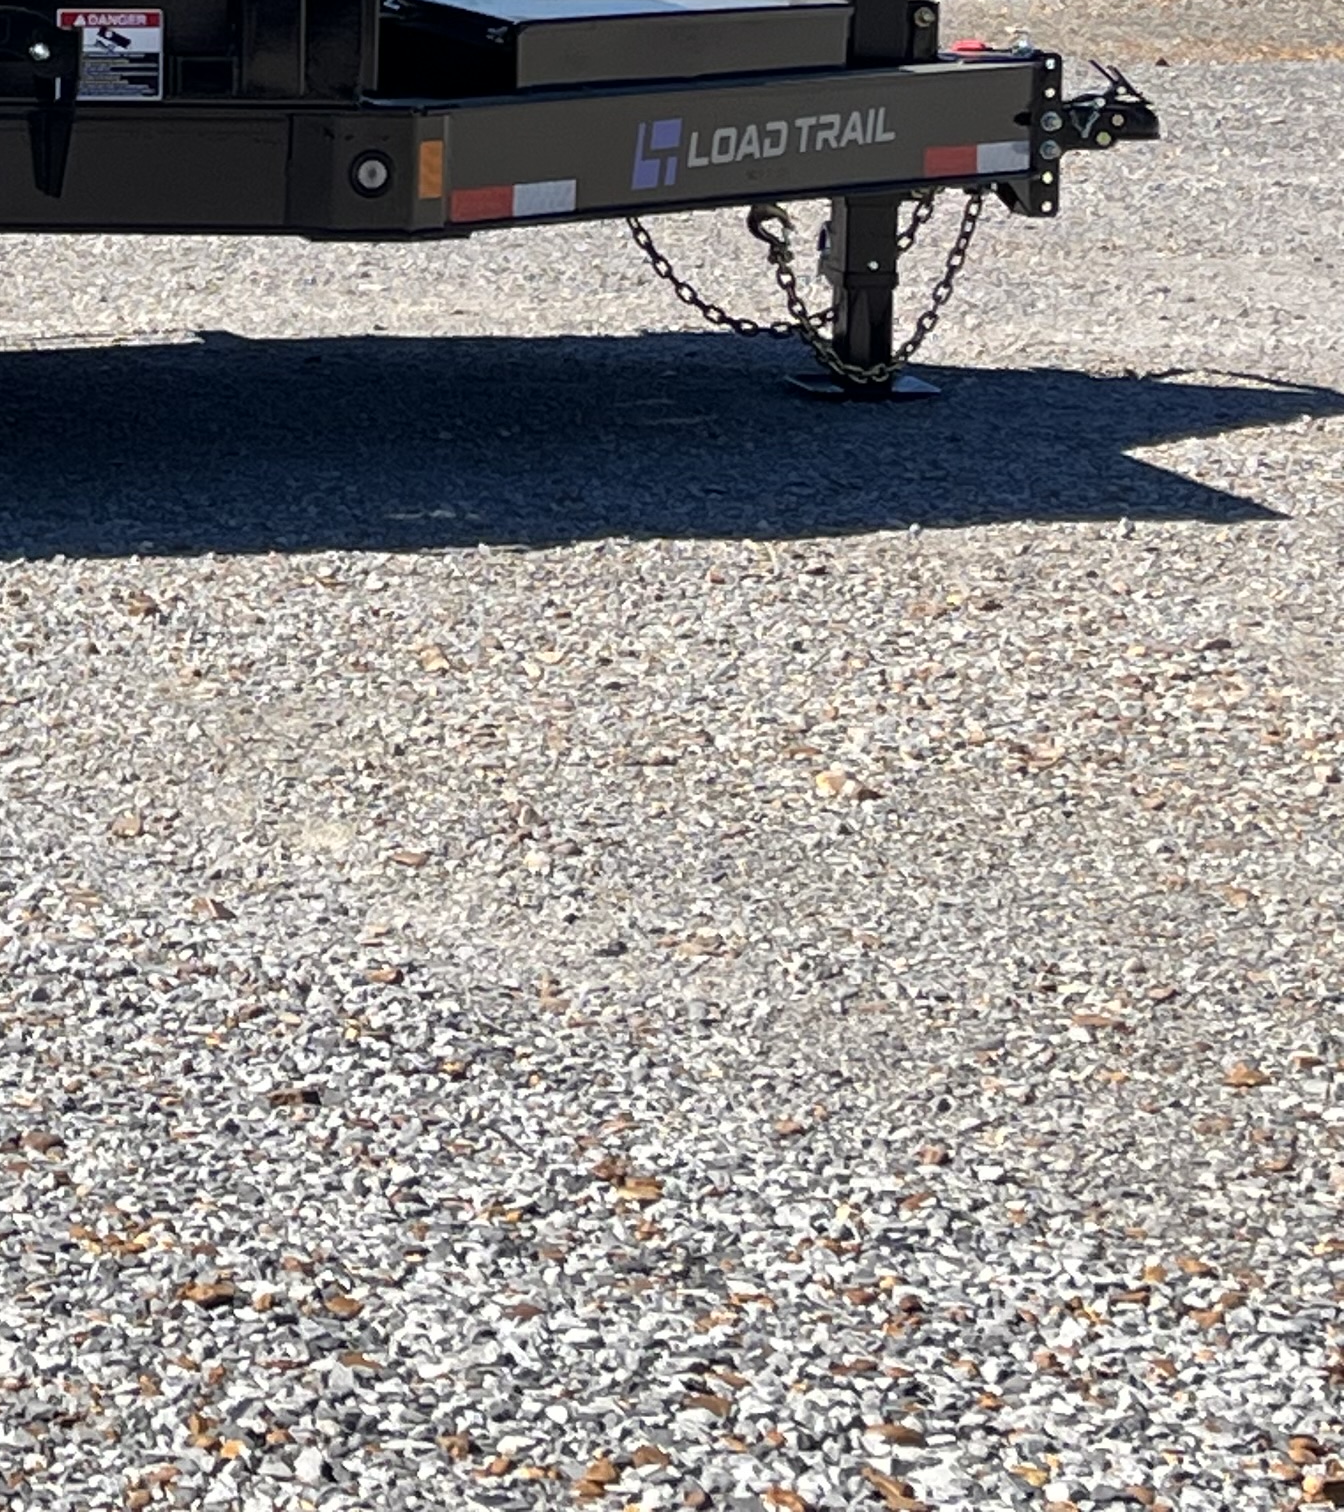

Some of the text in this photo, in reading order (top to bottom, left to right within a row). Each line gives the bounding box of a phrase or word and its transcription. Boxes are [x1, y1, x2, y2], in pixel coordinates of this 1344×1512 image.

[87, 13, 147, 26] DANGER
[687, 106, 897, 168] LOAD TRAIL
